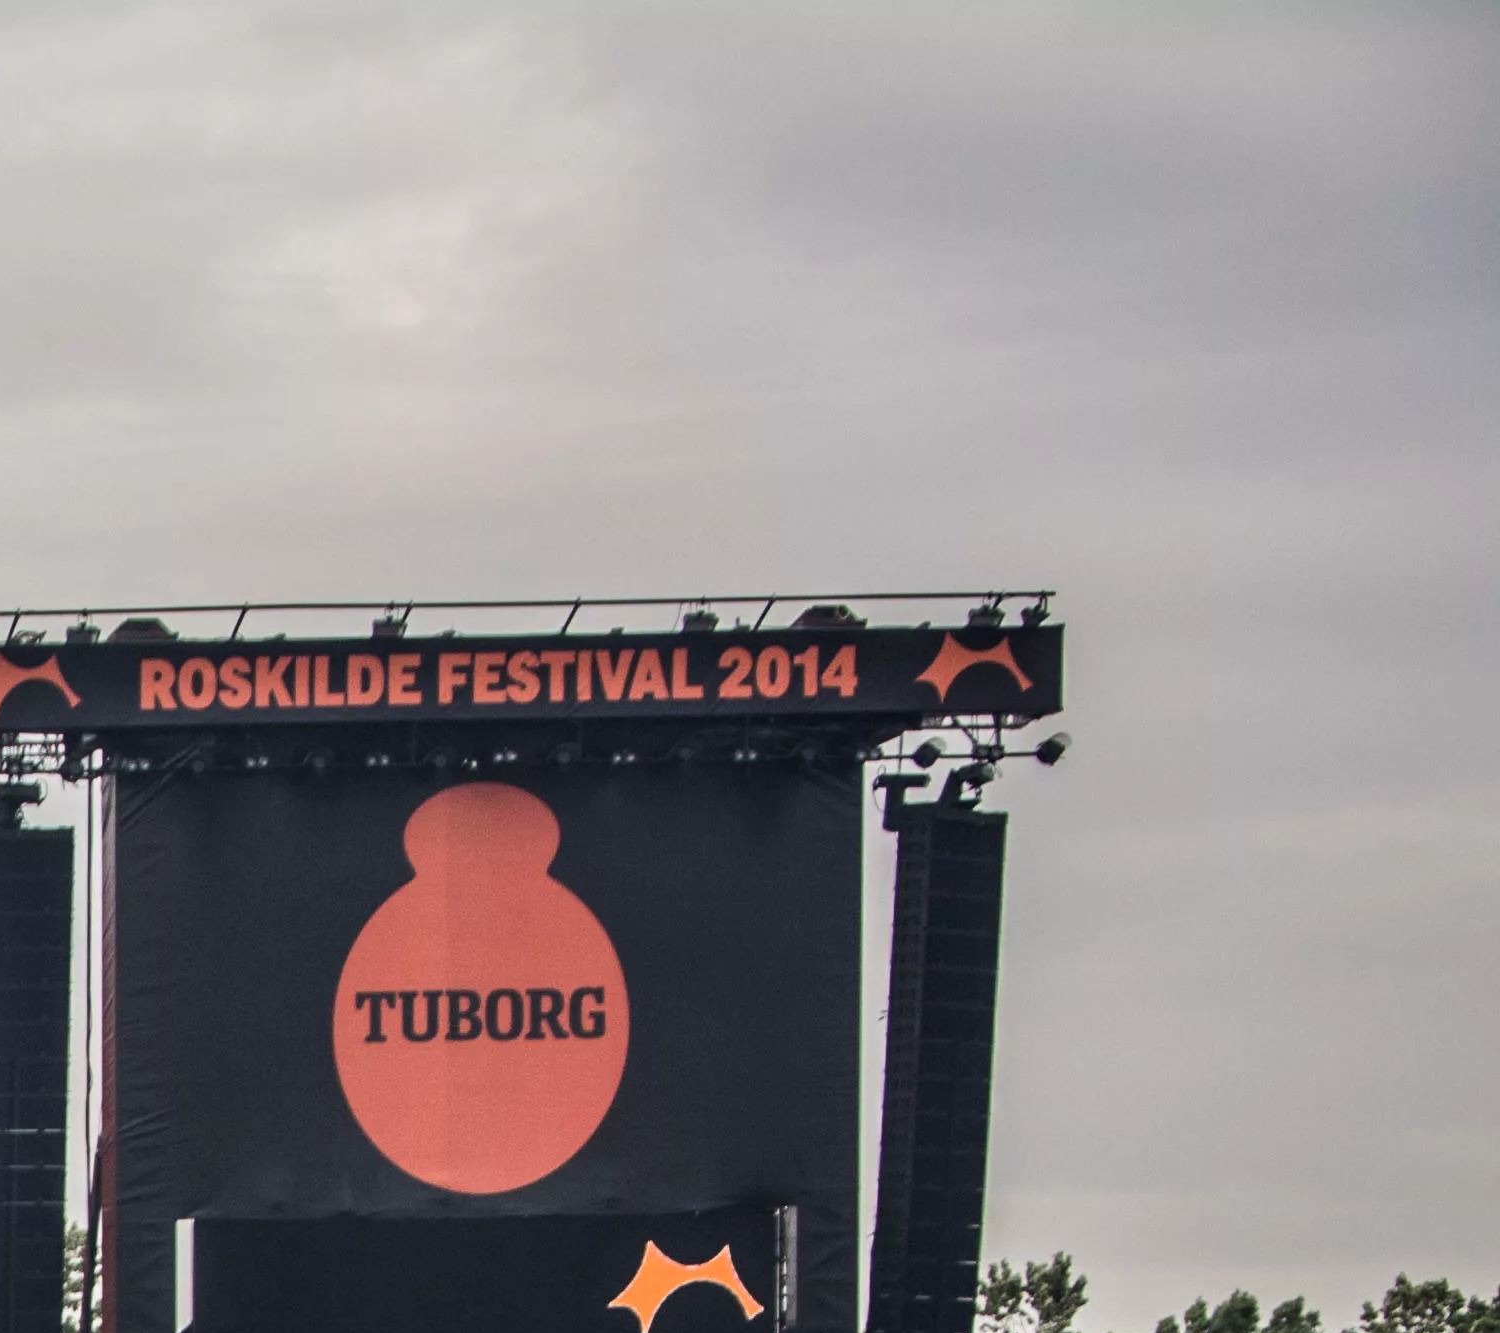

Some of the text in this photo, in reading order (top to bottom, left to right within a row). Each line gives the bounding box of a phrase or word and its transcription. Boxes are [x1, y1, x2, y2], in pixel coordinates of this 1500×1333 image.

[140, 644, 858, 710] ROSKILDE FESTIVAL 2014
[355, 986, 607, 1043] TUBORG
